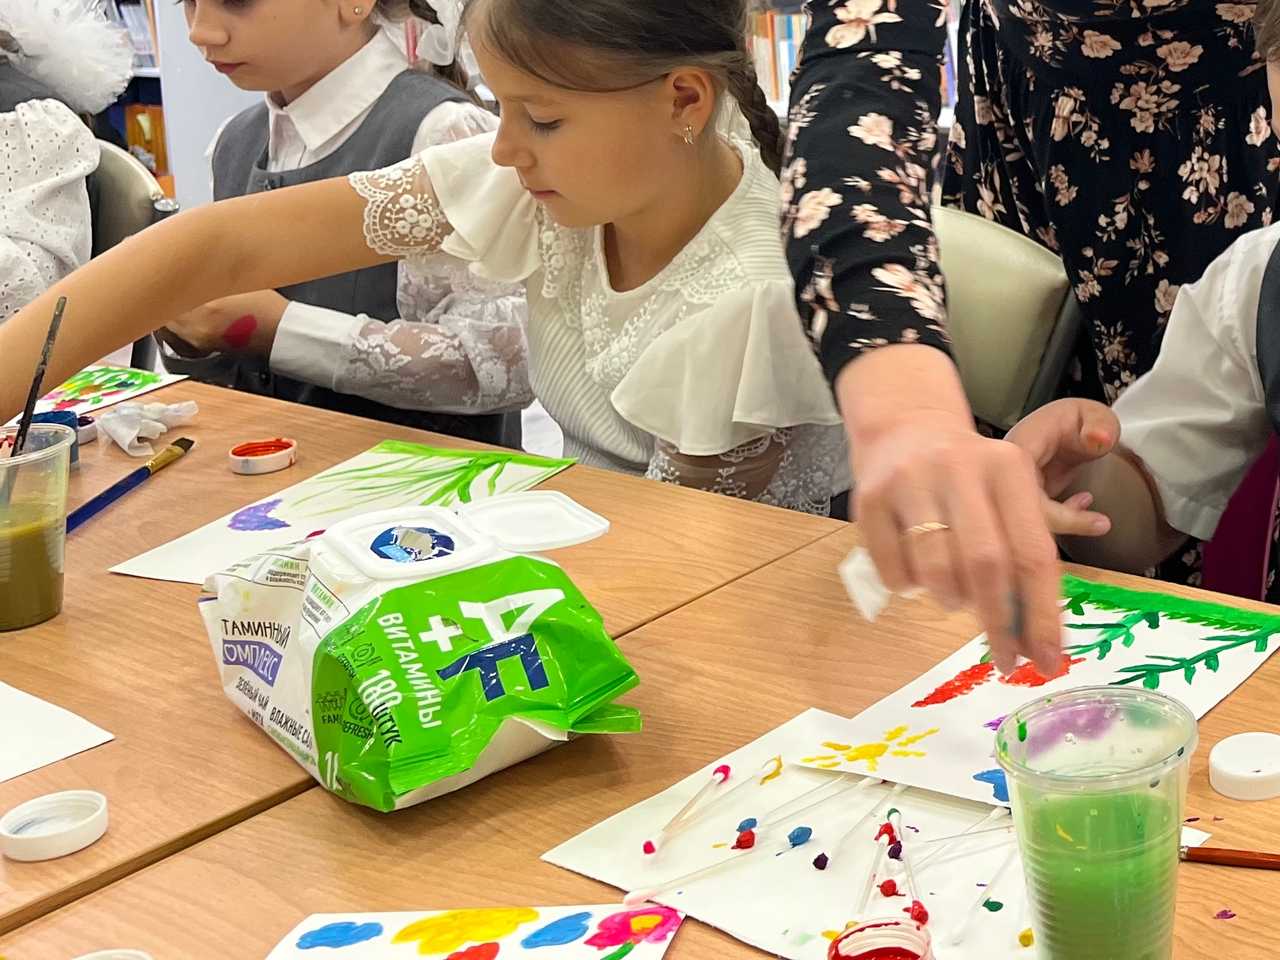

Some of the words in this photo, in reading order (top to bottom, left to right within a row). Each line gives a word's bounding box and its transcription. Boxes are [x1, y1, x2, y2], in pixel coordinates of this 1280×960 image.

[221, 618, 291, 649] ТАМИННЫЙ
[223, 643, 279, 681] ОМПЛЕКС
[376, 612, 443, 729] ВИТАМИНЫ
[357, 668, 402, 717] 180
[269, 706, 302, 741] ВЛАЖНЫЕ
[301, 728, 313, 750] САЛ
[371, 701, 403, 750] ШТУК
